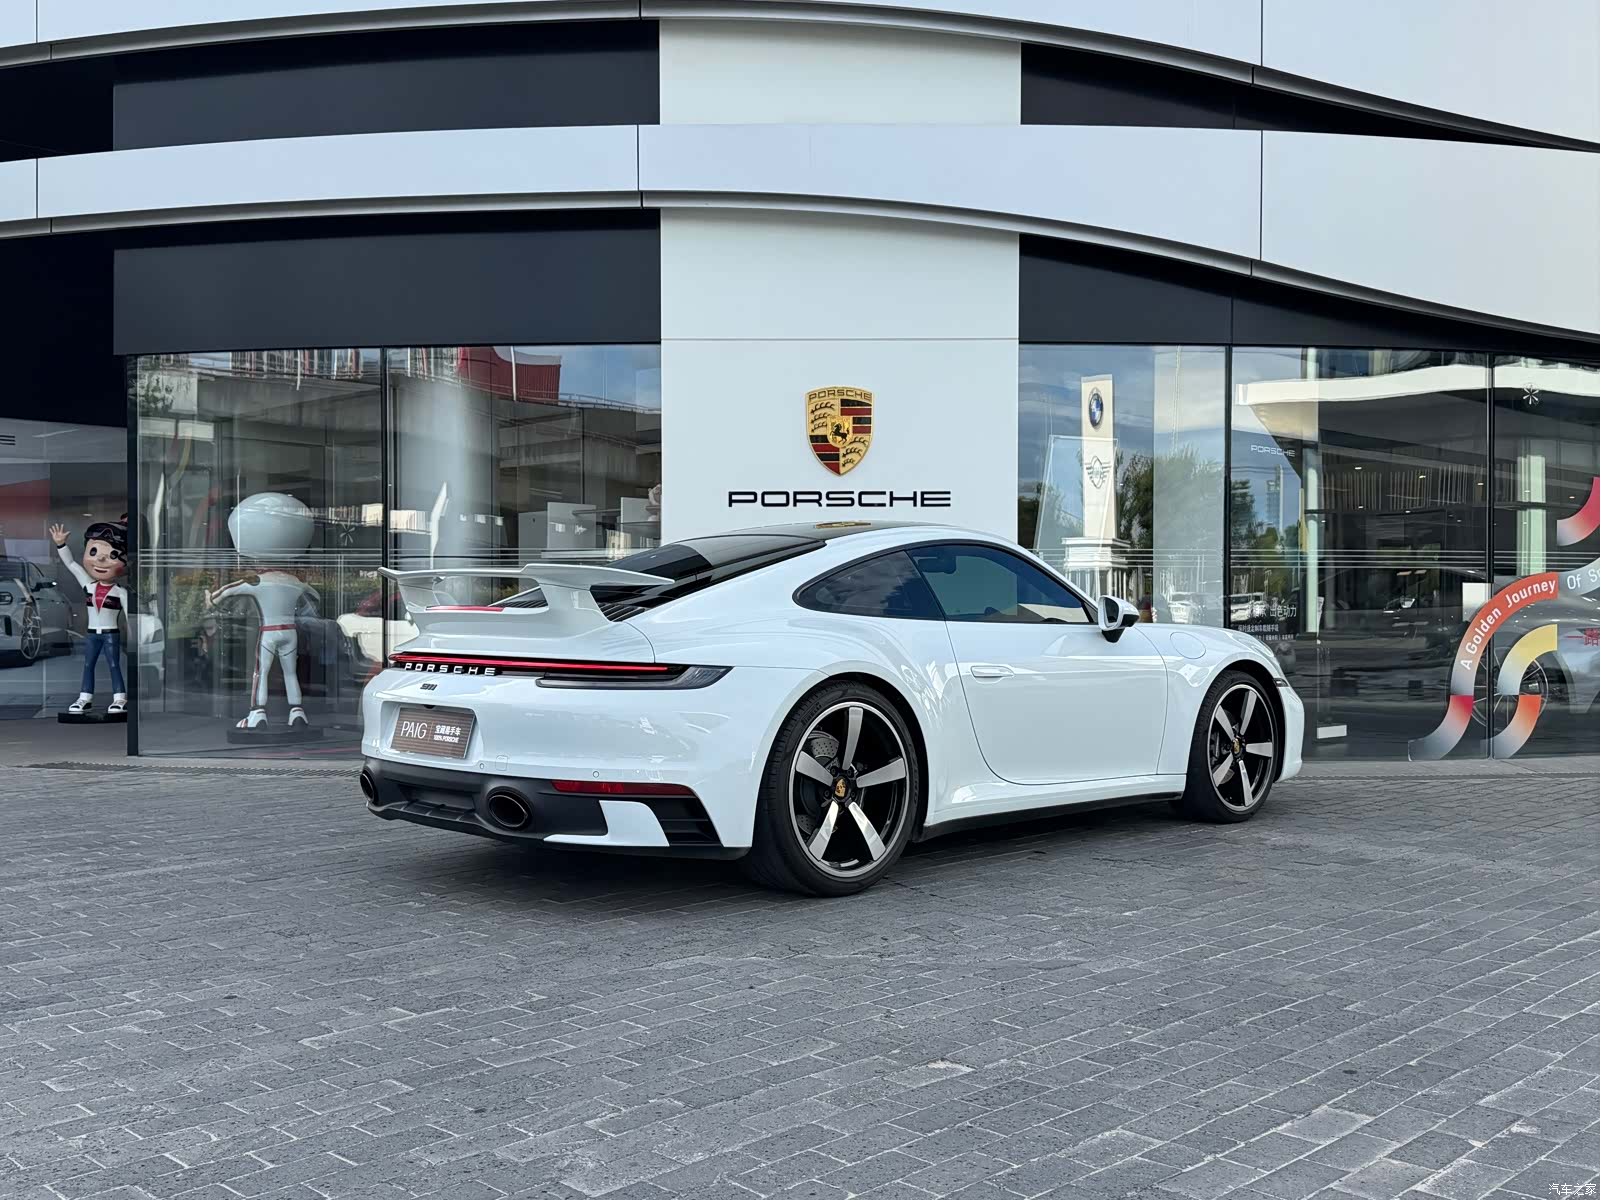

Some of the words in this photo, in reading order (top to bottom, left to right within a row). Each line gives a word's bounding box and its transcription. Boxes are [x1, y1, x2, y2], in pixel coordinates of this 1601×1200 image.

[808, 389, 872, 402] PORSCHE
[1250, 444, 1296, 457] PORSCHE
[728, 491, 951, 507] PORSCHE
[1567, 574, 1581, 590] Of
[1505, 580, 1556, 608] Journey
[1465, 607, 1502, 657] Golden
[404, 662, 496, 676] PORSCHE
[1460, 658, 1473, 670] A
[420, 683, 438, 691] 911
[400, 721, 428, 739] PAIG
